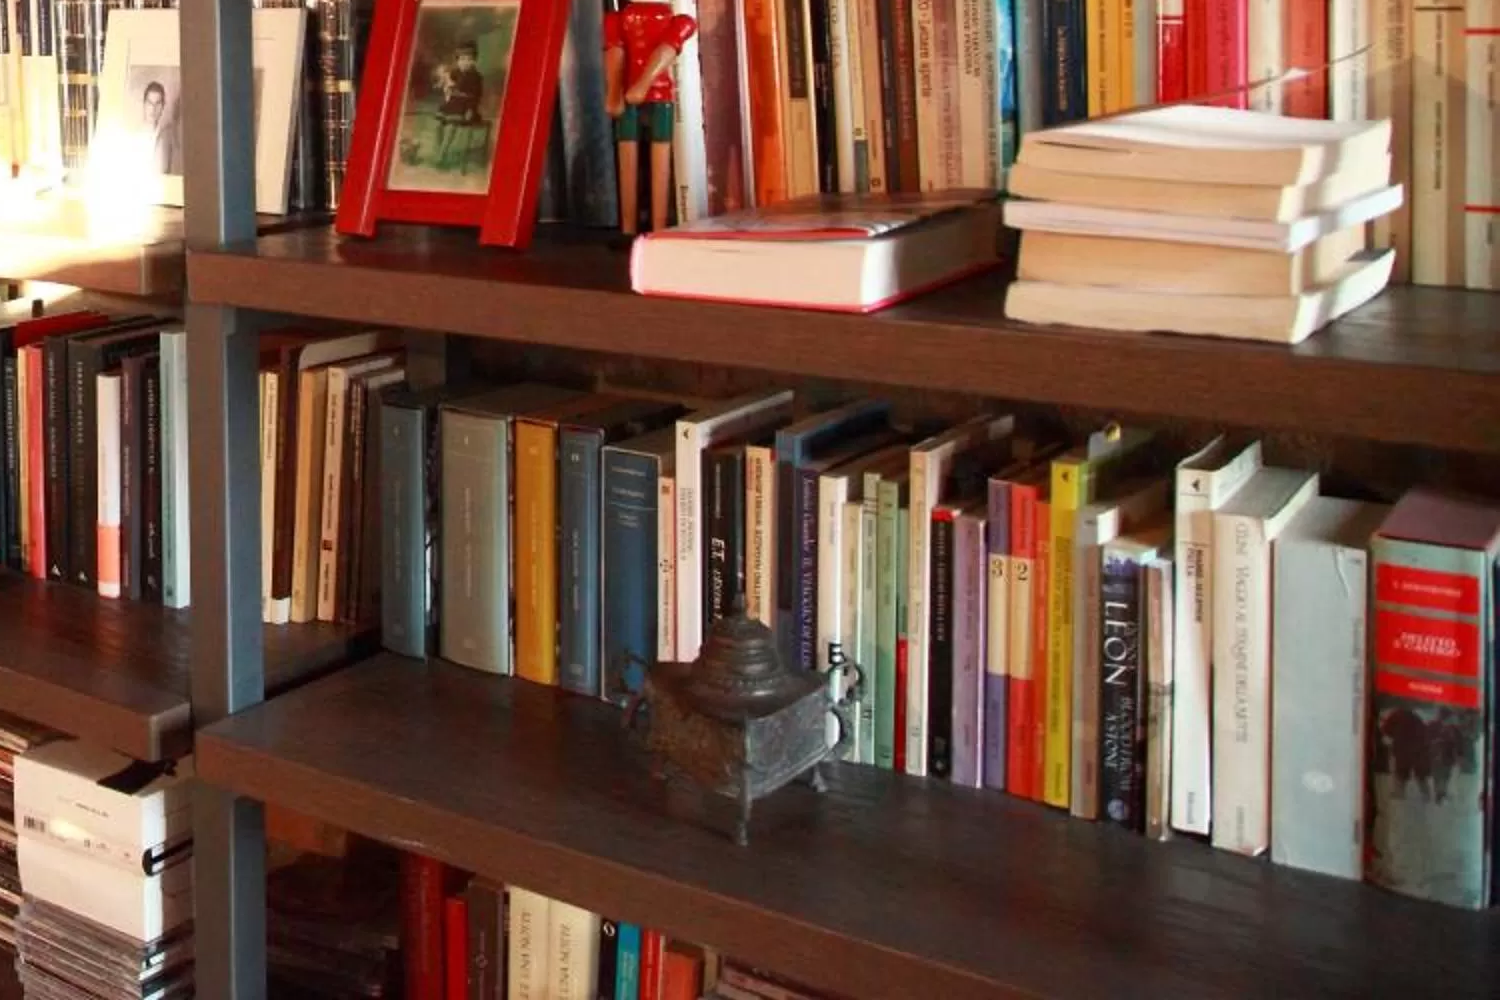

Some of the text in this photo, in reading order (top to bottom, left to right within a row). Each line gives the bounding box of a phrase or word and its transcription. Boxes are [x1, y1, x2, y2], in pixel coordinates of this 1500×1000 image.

[991, 558, 1003, 578] 3
[1014, 562, 1028, 582] 2
[1104, 600, 1129, 687] LEON
